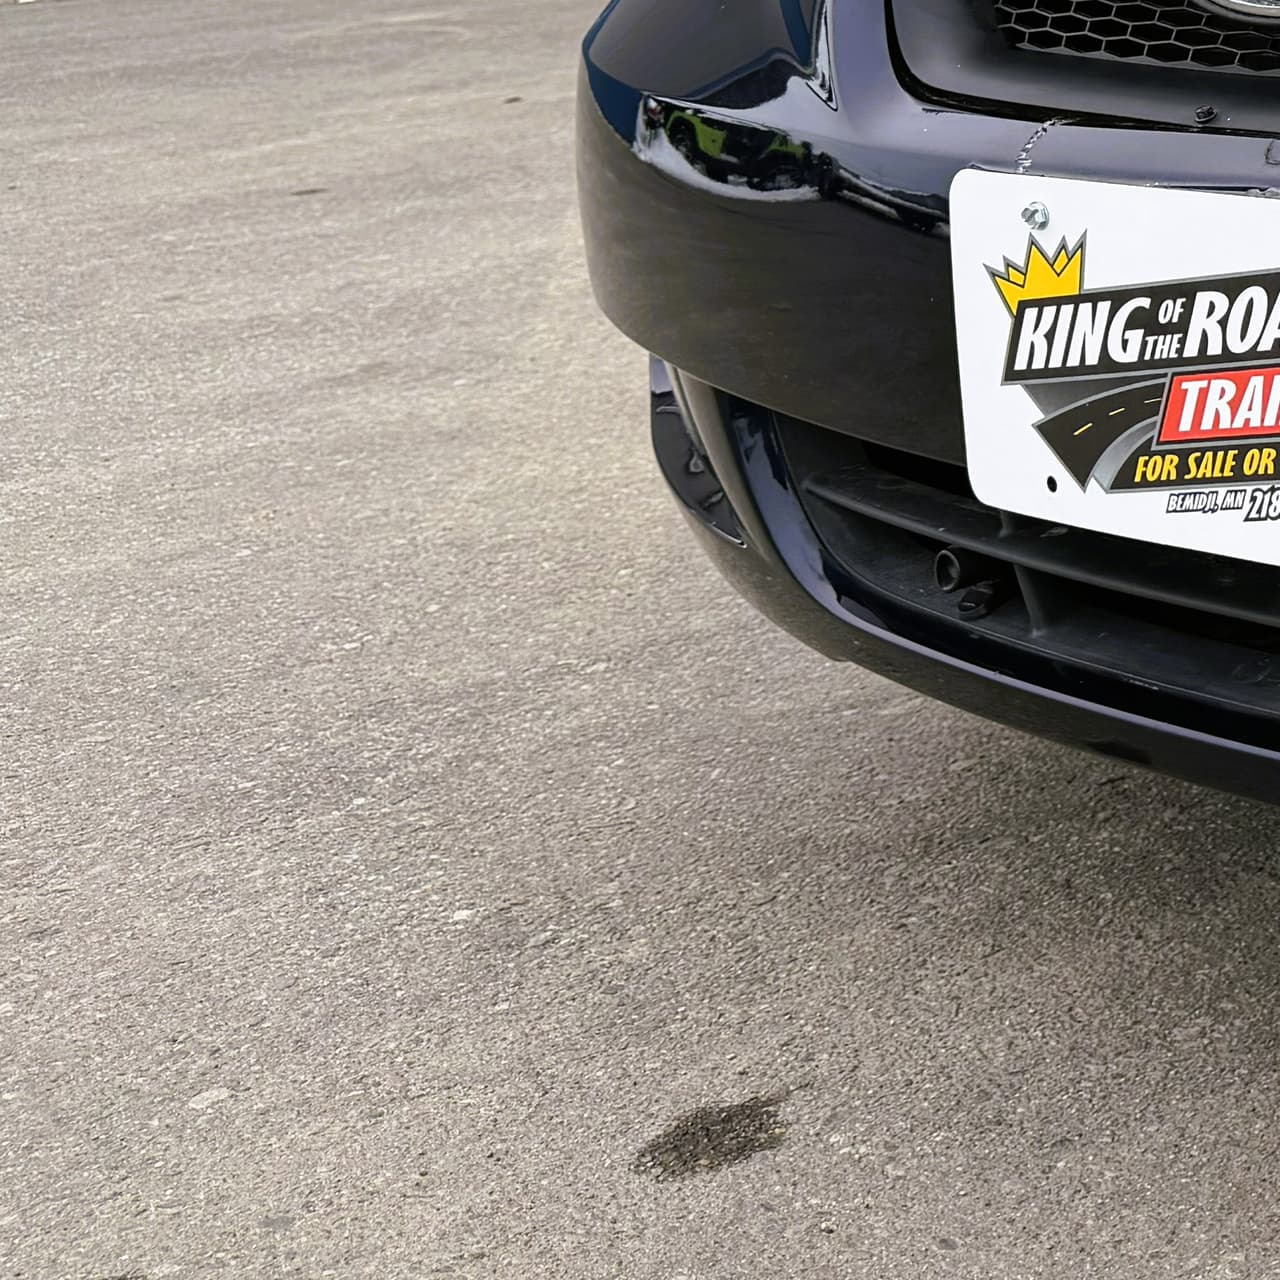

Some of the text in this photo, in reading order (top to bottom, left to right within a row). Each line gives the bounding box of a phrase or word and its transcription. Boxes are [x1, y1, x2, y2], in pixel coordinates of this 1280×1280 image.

[1012, 296, 1152, 372] KING
[1158, 297, 1185, 324] OF
[1145, 332, 1182, 362] THE
[1133, 453, 1178, 483] FOR
[1183, 450, 1236, 480] SALE
[1242, 447, 1274, 475] OR
[1166, 491, 1220, 514] BEMIDJI,
[1220, 489, 1247, 511] MN
